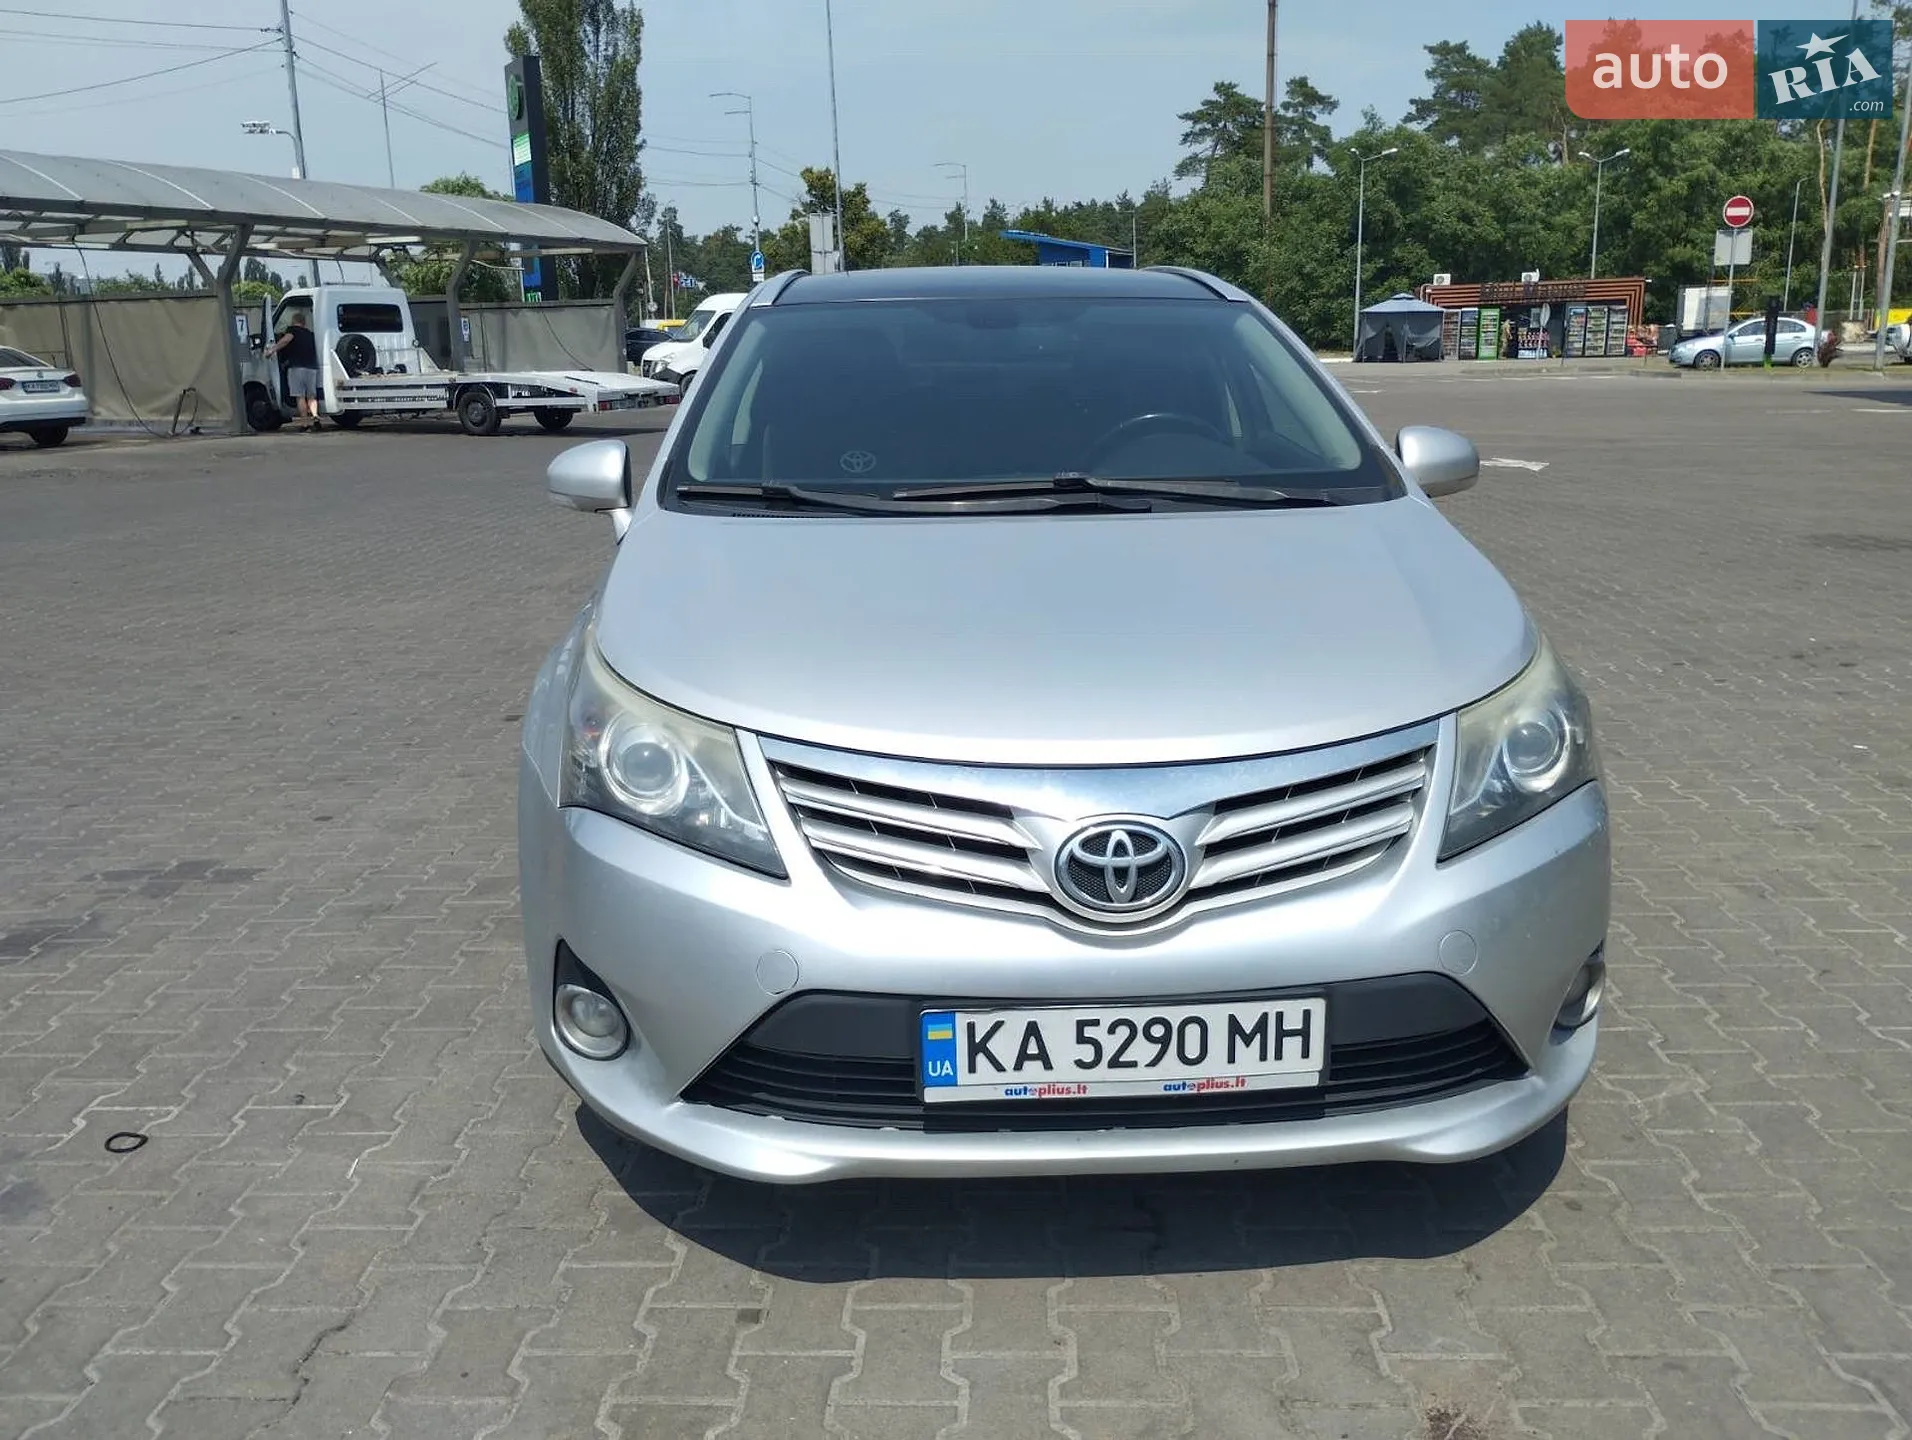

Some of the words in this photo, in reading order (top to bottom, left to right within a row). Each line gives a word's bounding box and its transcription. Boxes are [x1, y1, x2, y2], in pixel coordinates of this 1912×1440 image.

[966, 1020, 1053, 1073] KA
[1073, 1017, 1209, 1070] 5290
[1227, 1008, 1311, 1065] MH
[928, 1061, 954, 1076] UA
[1004, 1082, 1088, 1098] autoplius.lt
[1163, 1076, 1246, 1093] autoplius.lt
